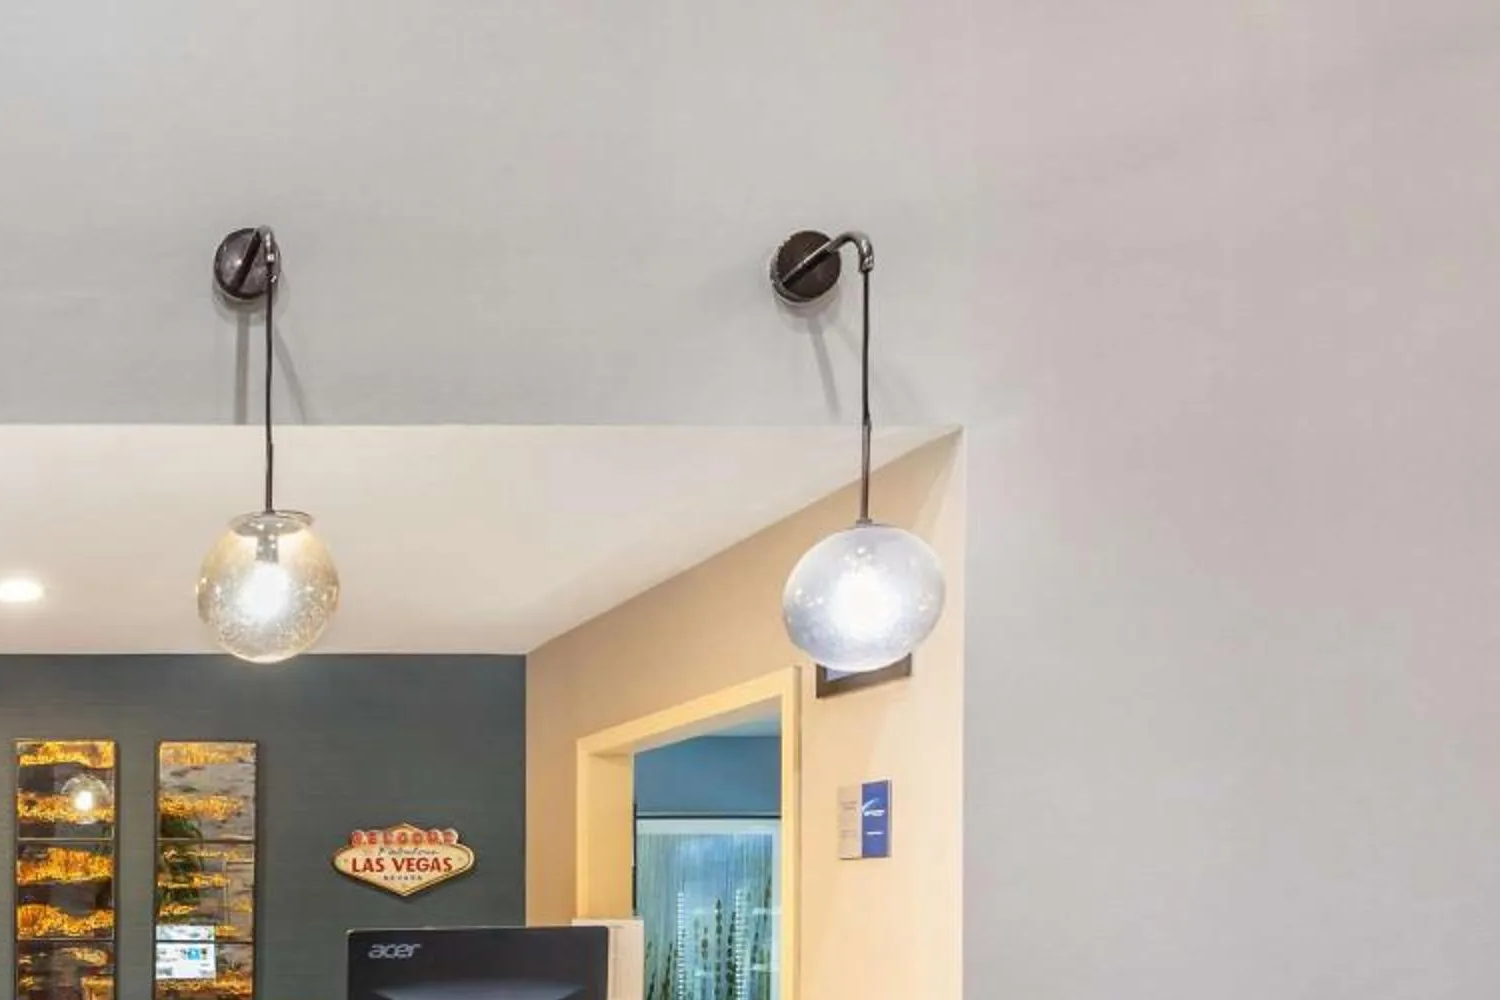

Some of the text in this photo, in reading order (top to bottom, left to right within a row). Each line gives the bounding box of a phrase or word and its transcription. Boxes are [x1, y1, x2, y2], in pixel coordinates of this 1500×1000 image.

[352, 857, 453, 873] LAS VEGAS
[368, 943, 421, 959] acer
